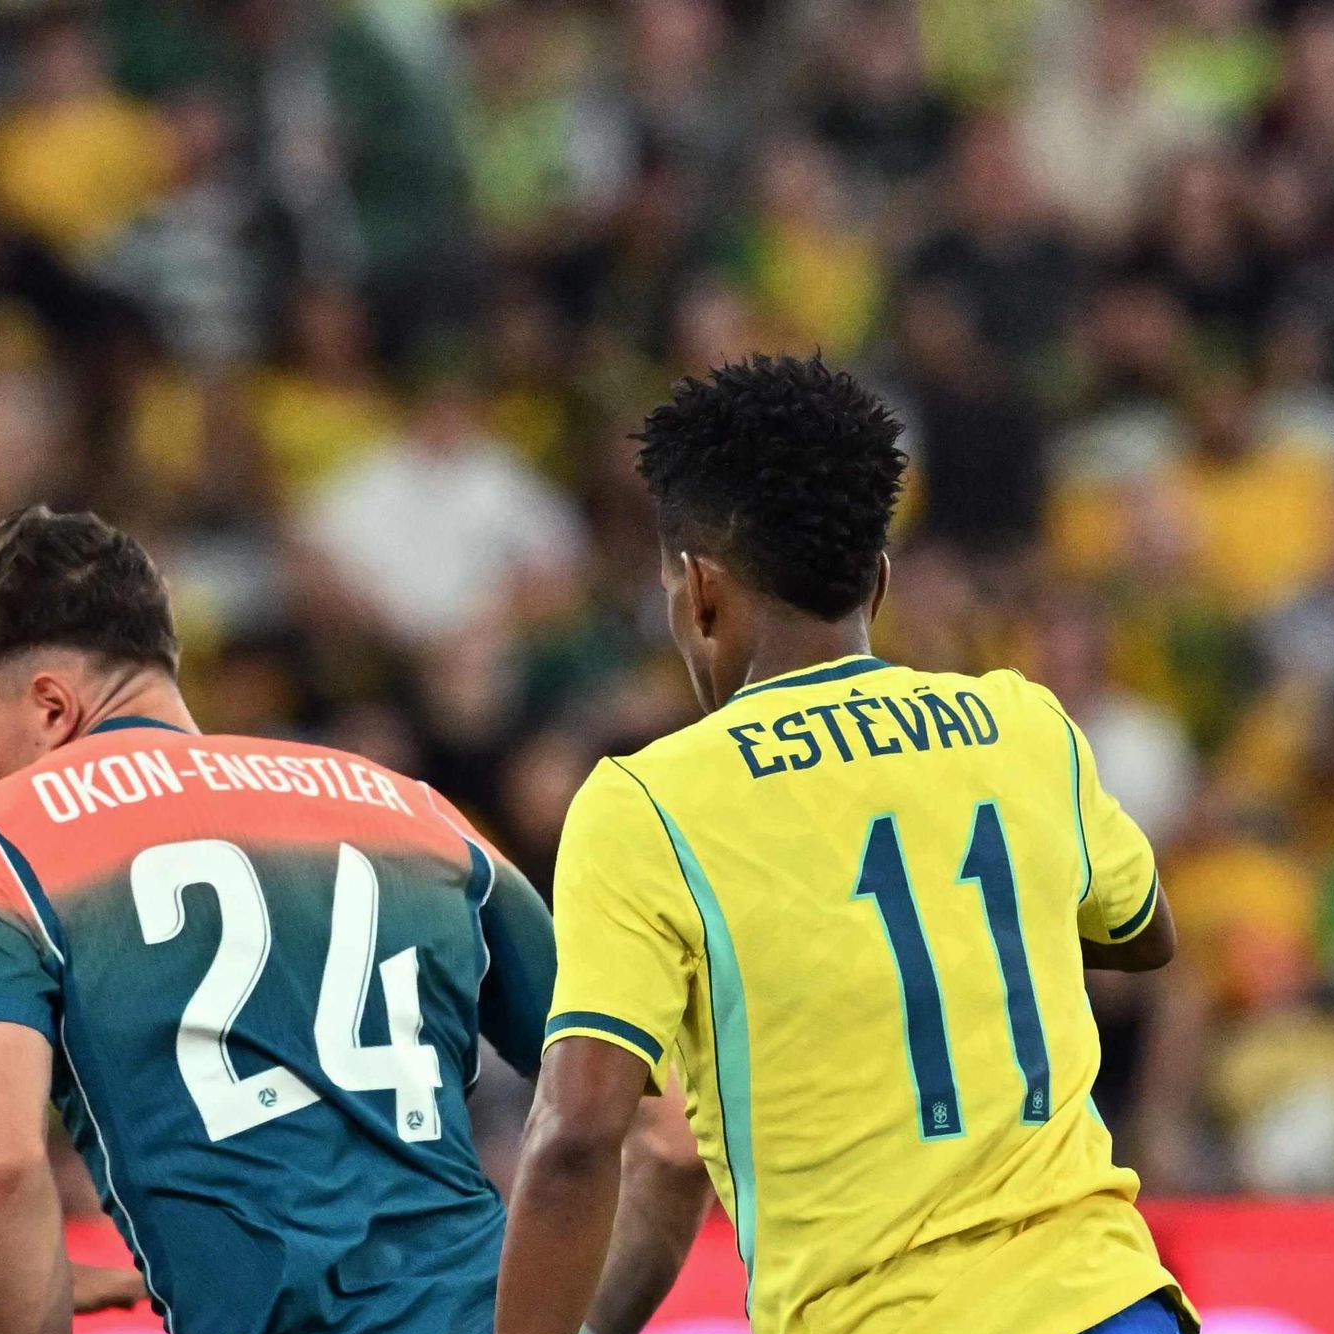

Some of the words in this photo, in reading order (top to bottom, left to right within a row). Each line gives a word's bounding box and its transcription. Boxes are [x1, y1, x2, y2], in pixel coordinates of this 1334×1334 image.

[31, 748, 415, 823] OKON-ENGSTLER
[727, 686, 999, 779] ESTÊVÃO
[130, 838, 442, 1143] 24
[851, 800, 1051, 1142] 11
